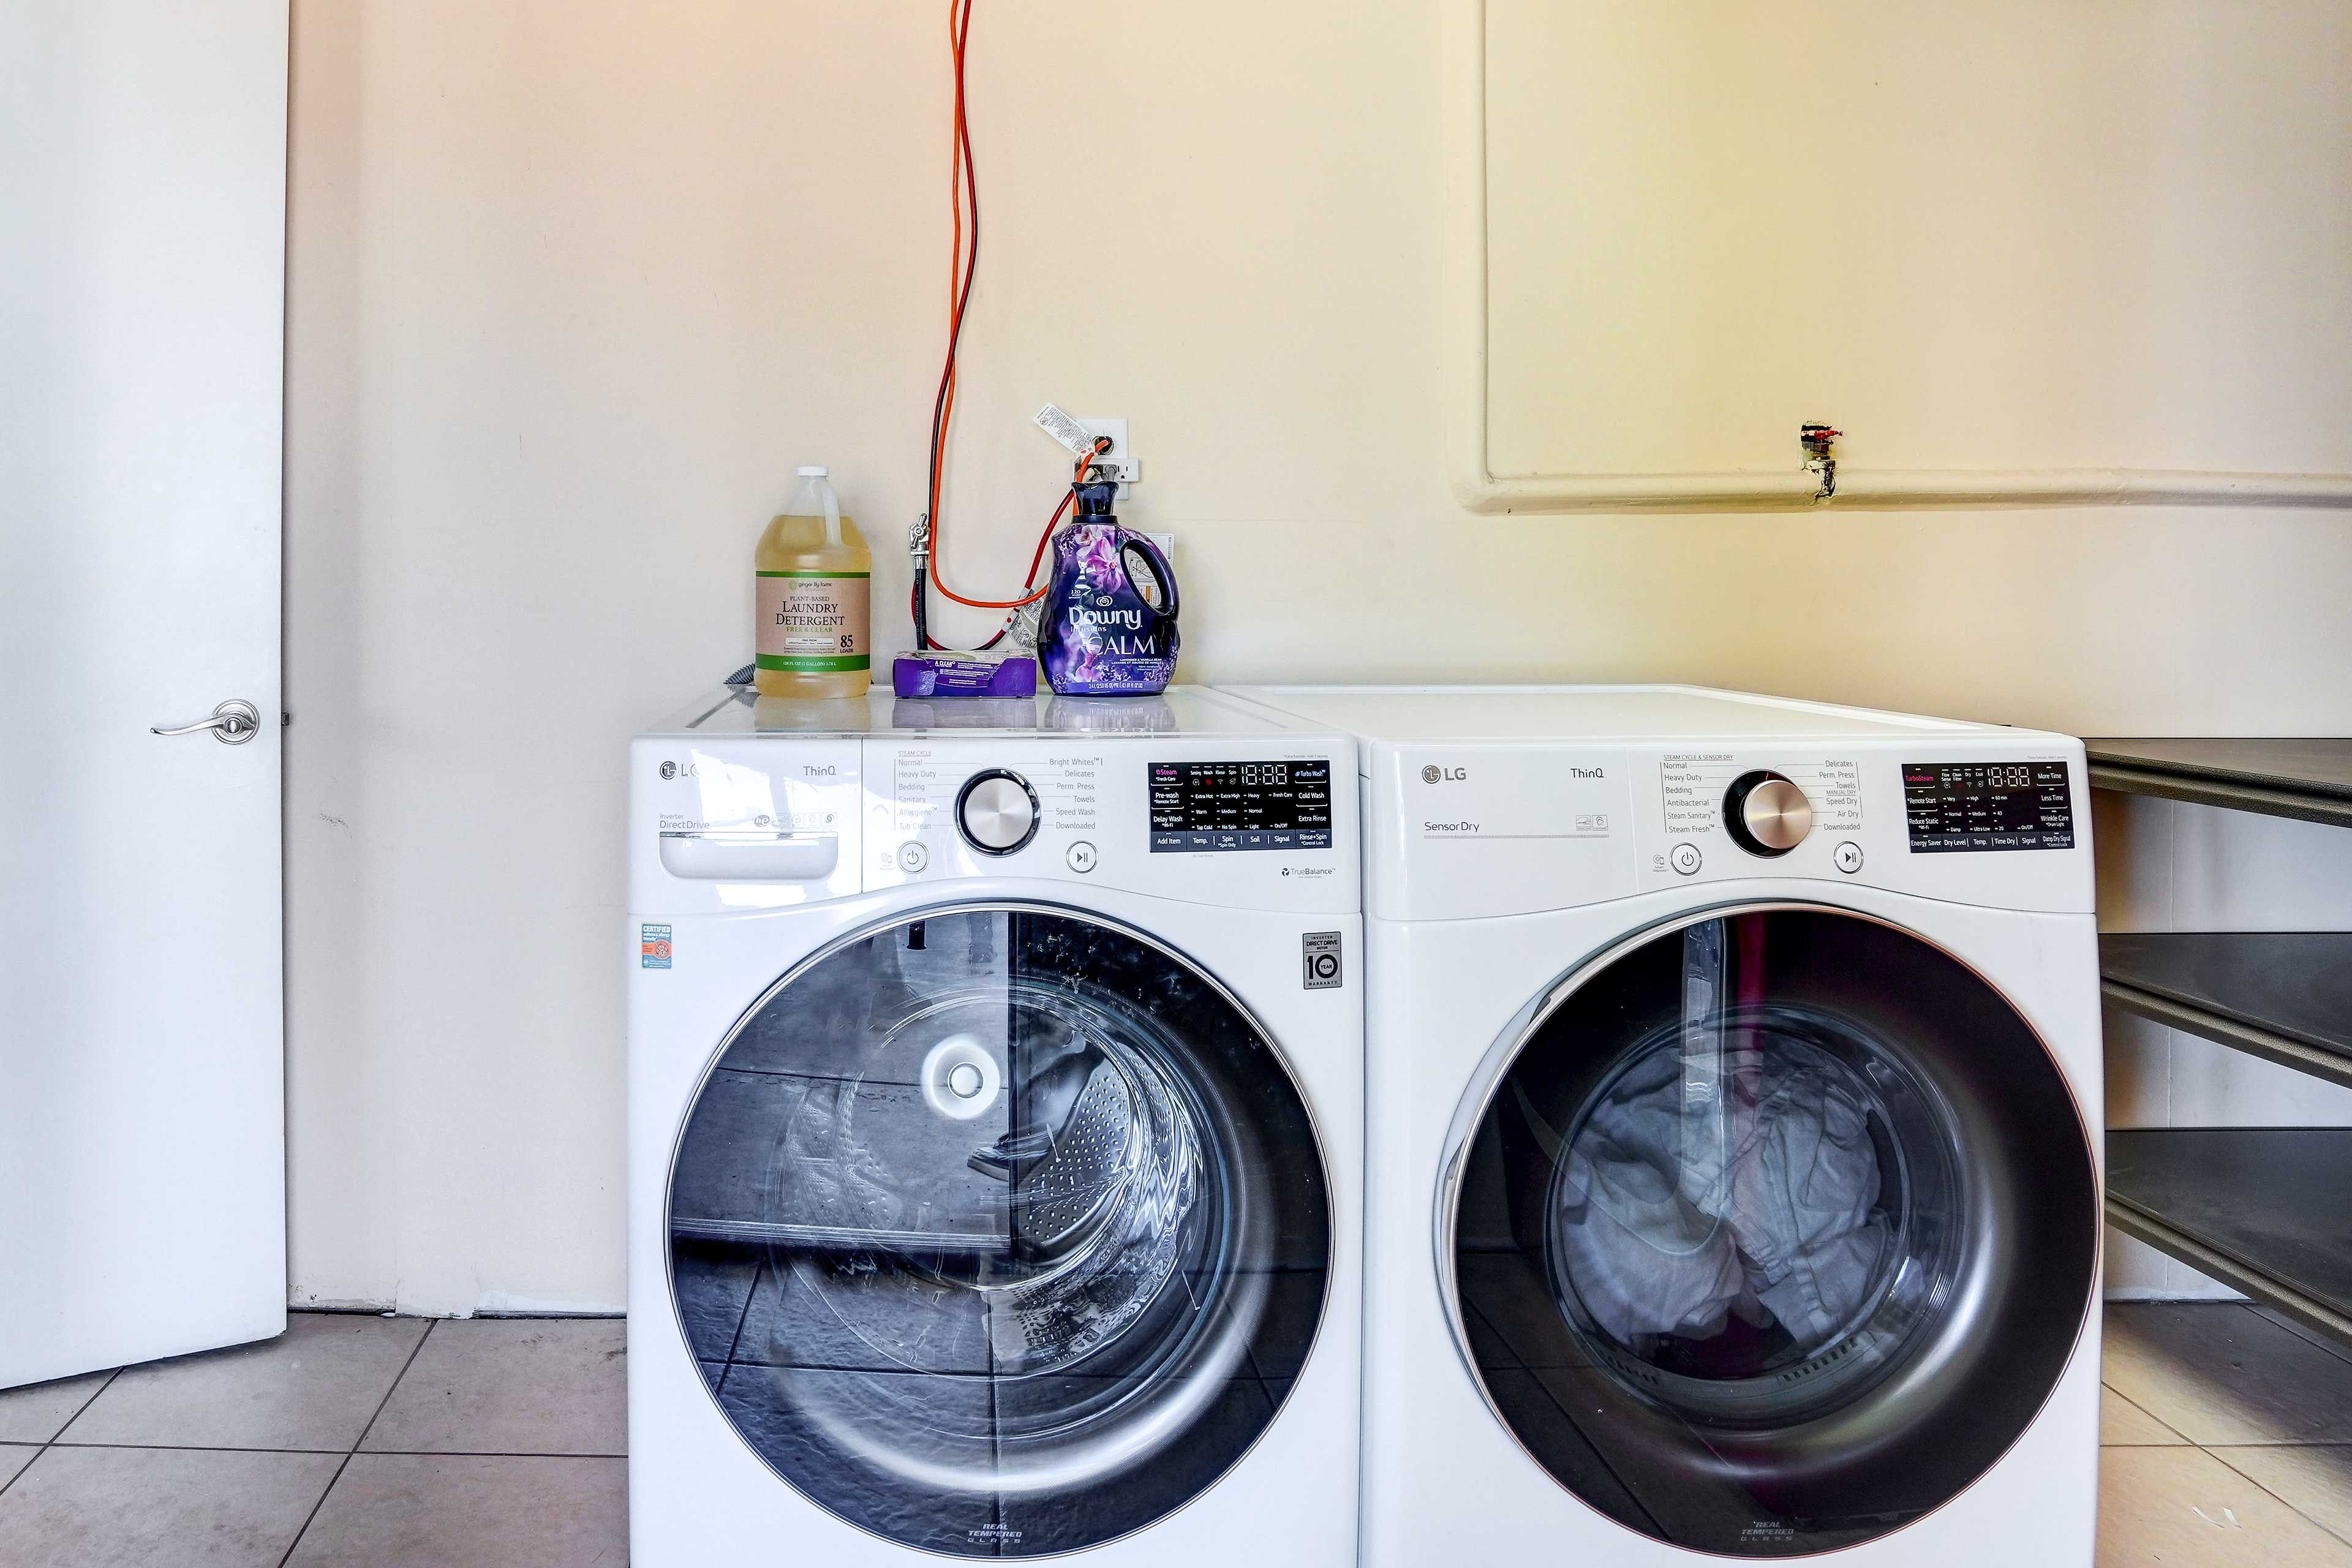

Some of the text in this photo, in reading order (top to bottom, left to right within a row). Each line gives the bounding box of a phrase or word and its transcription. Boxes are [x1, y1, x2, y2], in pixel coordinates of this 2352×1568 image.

[782, 601, 838, 612] LAUNDRY
[775, 613, 845, 625] DETERGENT
[1069, 606, 1142, 630] Downy
[840, 635, 853, 648] 85
[1086, 636, 1155, 655] CALM
[1049, 758, 1069, 767] Bright
[804, 766, 837, 776] ThinQ
[921, 770, 936, 779] Duty
[1444, 767, 1466, 781] LG
[1570, 767, 1604, 778] ThinQ
[1686, 774, 1702, 782] Duty
[899, 783, 925, 792] Bedding
[1665, 786, 1692, 795] Bedding
[1826, 797, 1857, 806] Speed Dry
[1056, 808, 1076, 816] Speed
[1848, 810, 1859, 819] Dry
[1307, 954, 1338, 979] 10
